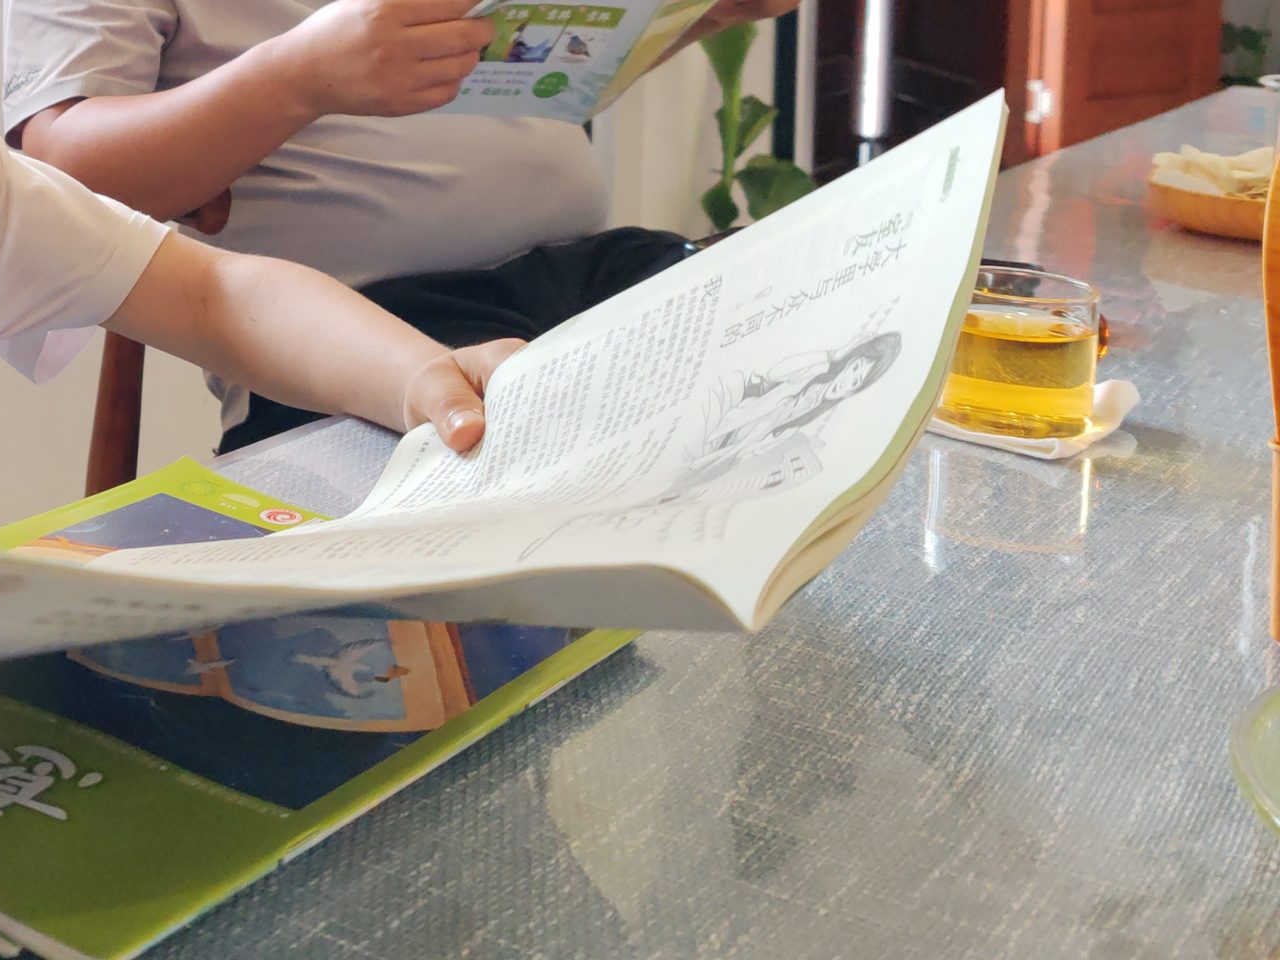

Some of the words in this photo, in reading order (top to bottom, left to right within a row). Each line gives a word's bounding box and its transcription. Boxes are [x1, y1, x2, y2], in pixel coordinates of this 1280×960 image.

[720, 239, 908, 348] 大学里与众不同的
